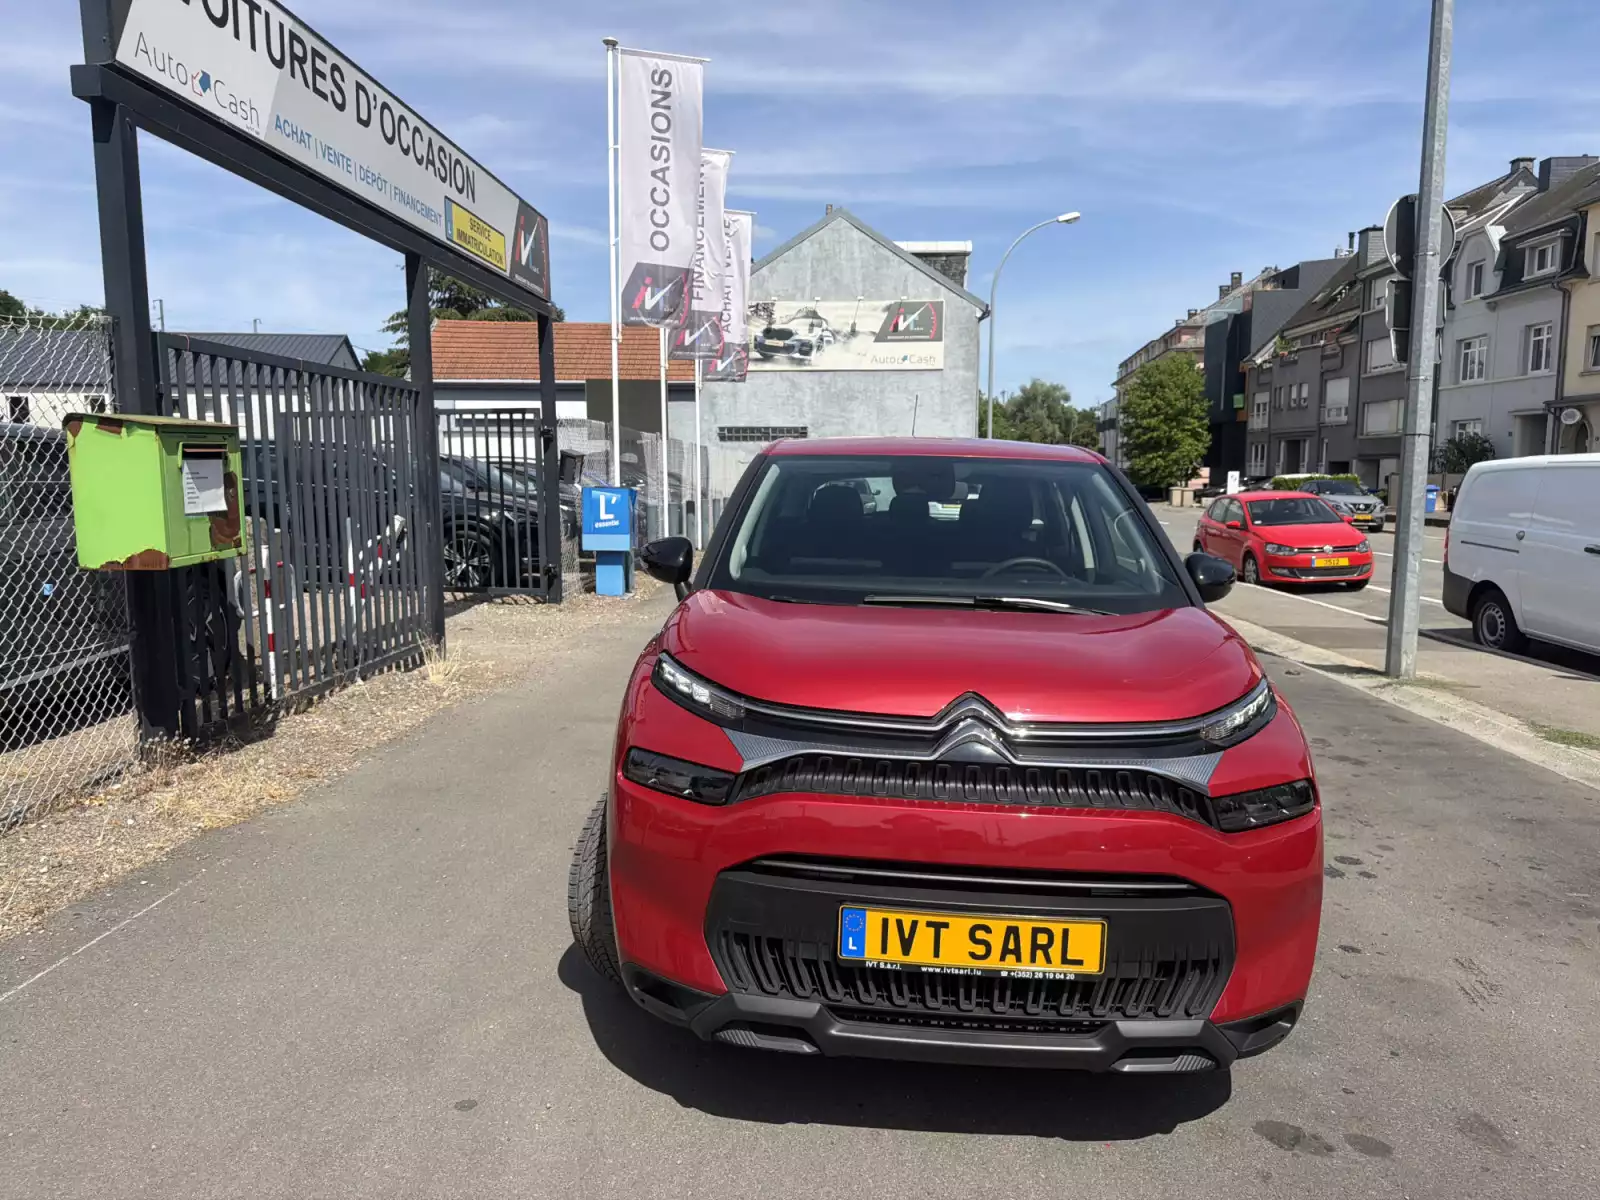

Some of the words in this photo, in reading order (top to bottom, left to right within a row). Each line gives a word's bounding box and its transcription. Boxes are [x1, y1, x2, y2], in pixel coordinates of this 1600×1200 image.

[182, 0, 347, 112] OITURES
[134, 32, 189, 87] Auto
[213, 79, 261, 129] Cash
[274, 115, 312, 150] ACHAT
[320, 141, 353, 175] VENTE
[359, 166, 389, 196] DÉPÔT
[393, 187, 443, 227] FINANCEMENT
[650, 68, 673, 252] OCCASIONS
[456, 227, 504, 267] IMMATRICULATION
[469, 217, 492, 243] SERVICE
[870, 354, 896, 364] Auto
[909, 354, 936, 365] Cash
[848, 936, 857, 950] L
[879, 917, 950, 959] IVT
[967, 923, 1084, 967] SARL
[865, 960, 878, 968] IVT
[920, 965, 982, 976] www.ivtsarl.lu
